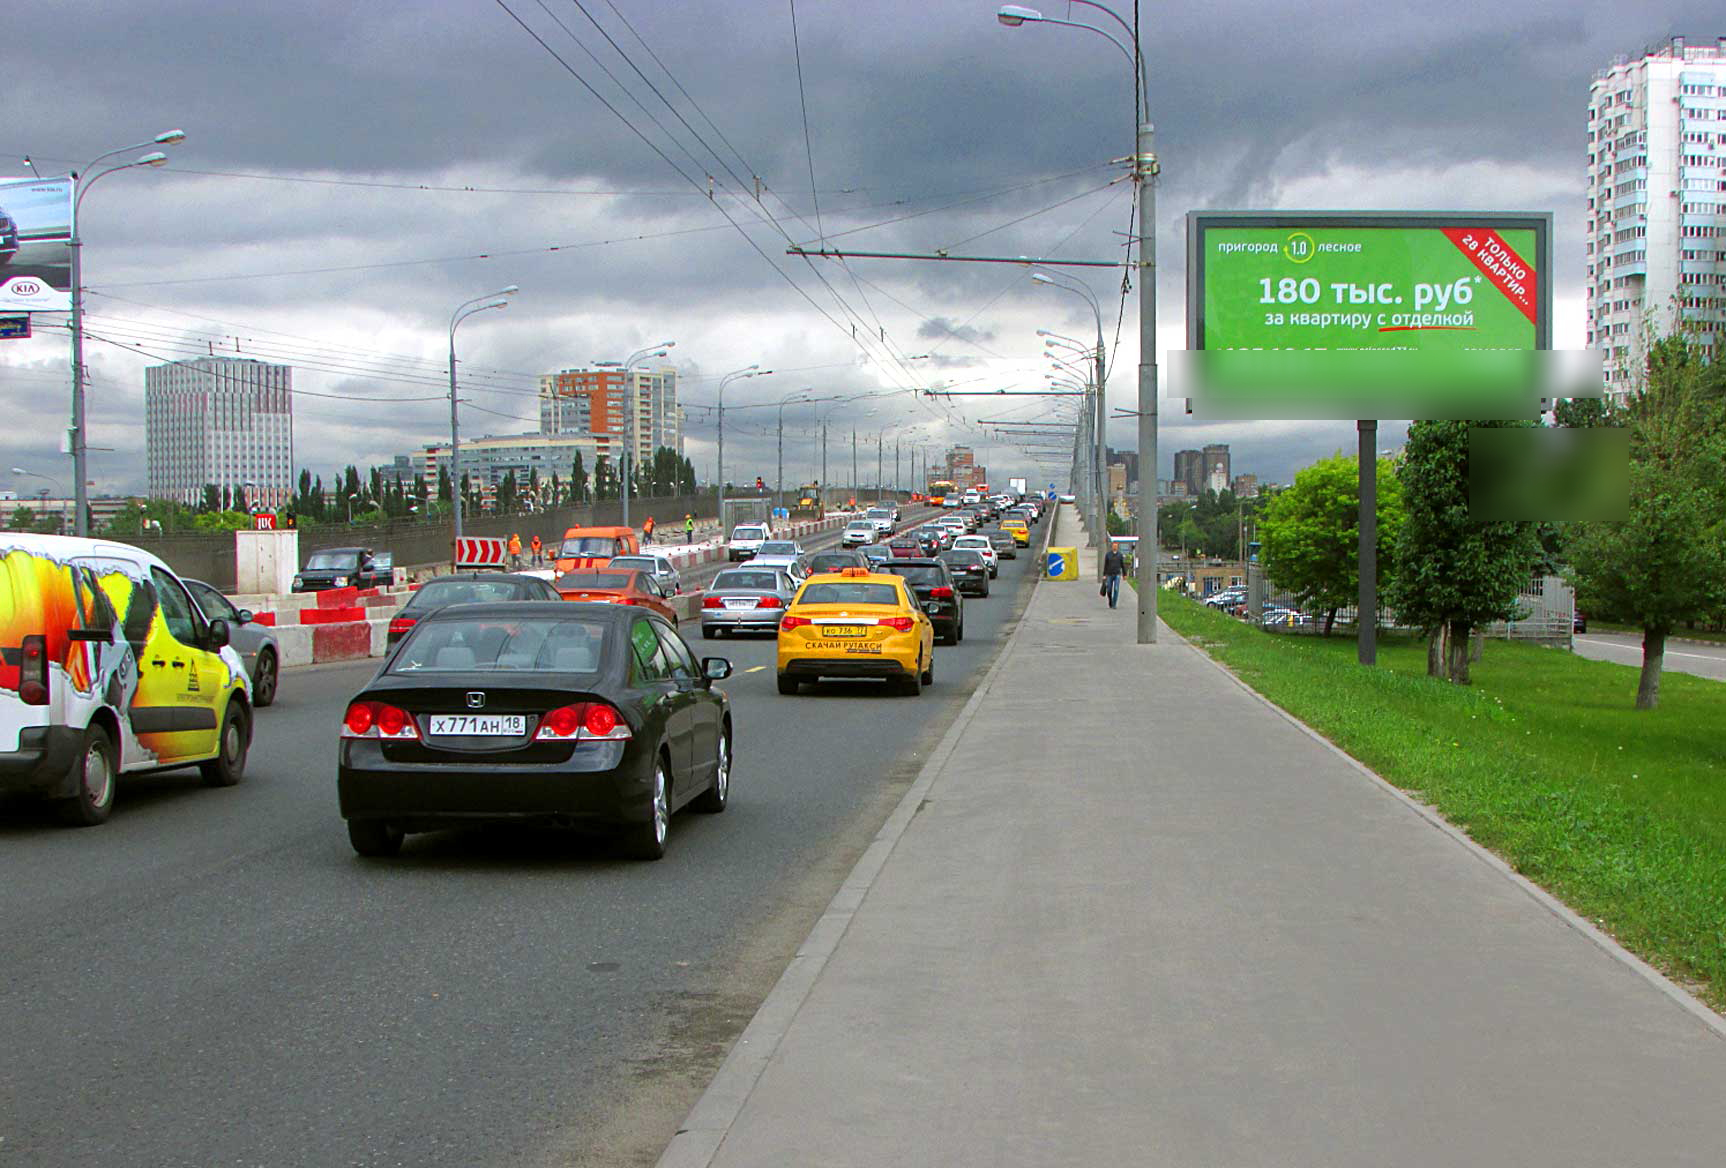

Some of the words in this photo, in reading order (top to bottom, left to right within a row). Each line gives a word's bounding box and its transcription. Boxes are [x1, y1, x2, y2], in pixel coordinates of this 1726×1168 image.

[1218, 242, 1278, 254] пригород
[1291, 240, 1307, 255] 1.0
[1318, 242, 1362, 252] лесное
[1462, 234, 1479, 251] 28
[1484, 237, 1526, 280] ТОЛЬКО
[16, 285, 35, 293] KIA
[1259, 277, 1321, 304] 180
[1331, 283, 1403, 304] тыс.
[1265, 313, 1285, 325] за
[1290, 313, 1372, 328] квартиру
[1377, 313, 1387, 325] с
[1391, 310, 1474, 328] отделкой
[505, 717, 520, 729] 18
